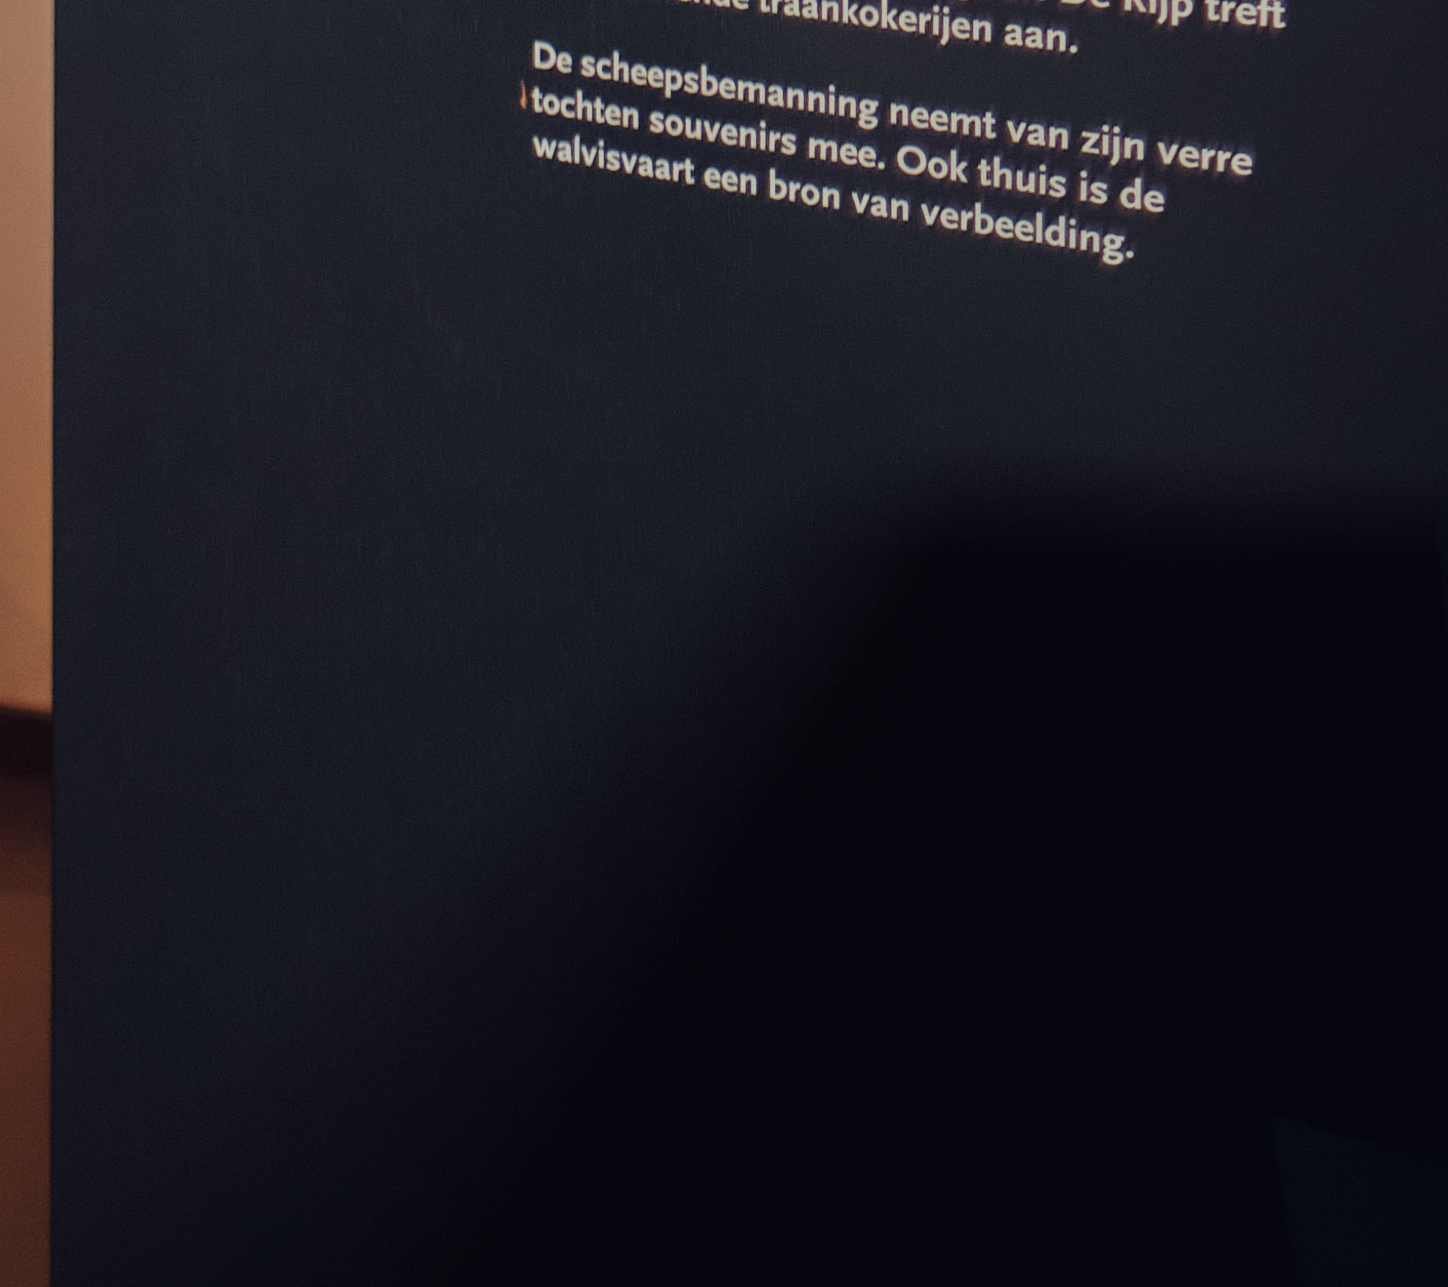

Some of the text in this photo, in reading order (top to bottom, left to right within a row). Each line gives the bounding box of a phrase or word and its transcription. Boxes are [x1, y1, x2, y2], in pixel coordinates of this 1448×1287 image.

[1004, 24, 1078, 54] aan.
[530, 85, 1165, 213] tochten souvenirs mee. Ook thuis is de
[533, 40, 1253, 176] De scheepsbemanning neemt van zijn verre
[533, 134, 1134, 265] walvisvaart een bron van verbeelding.
